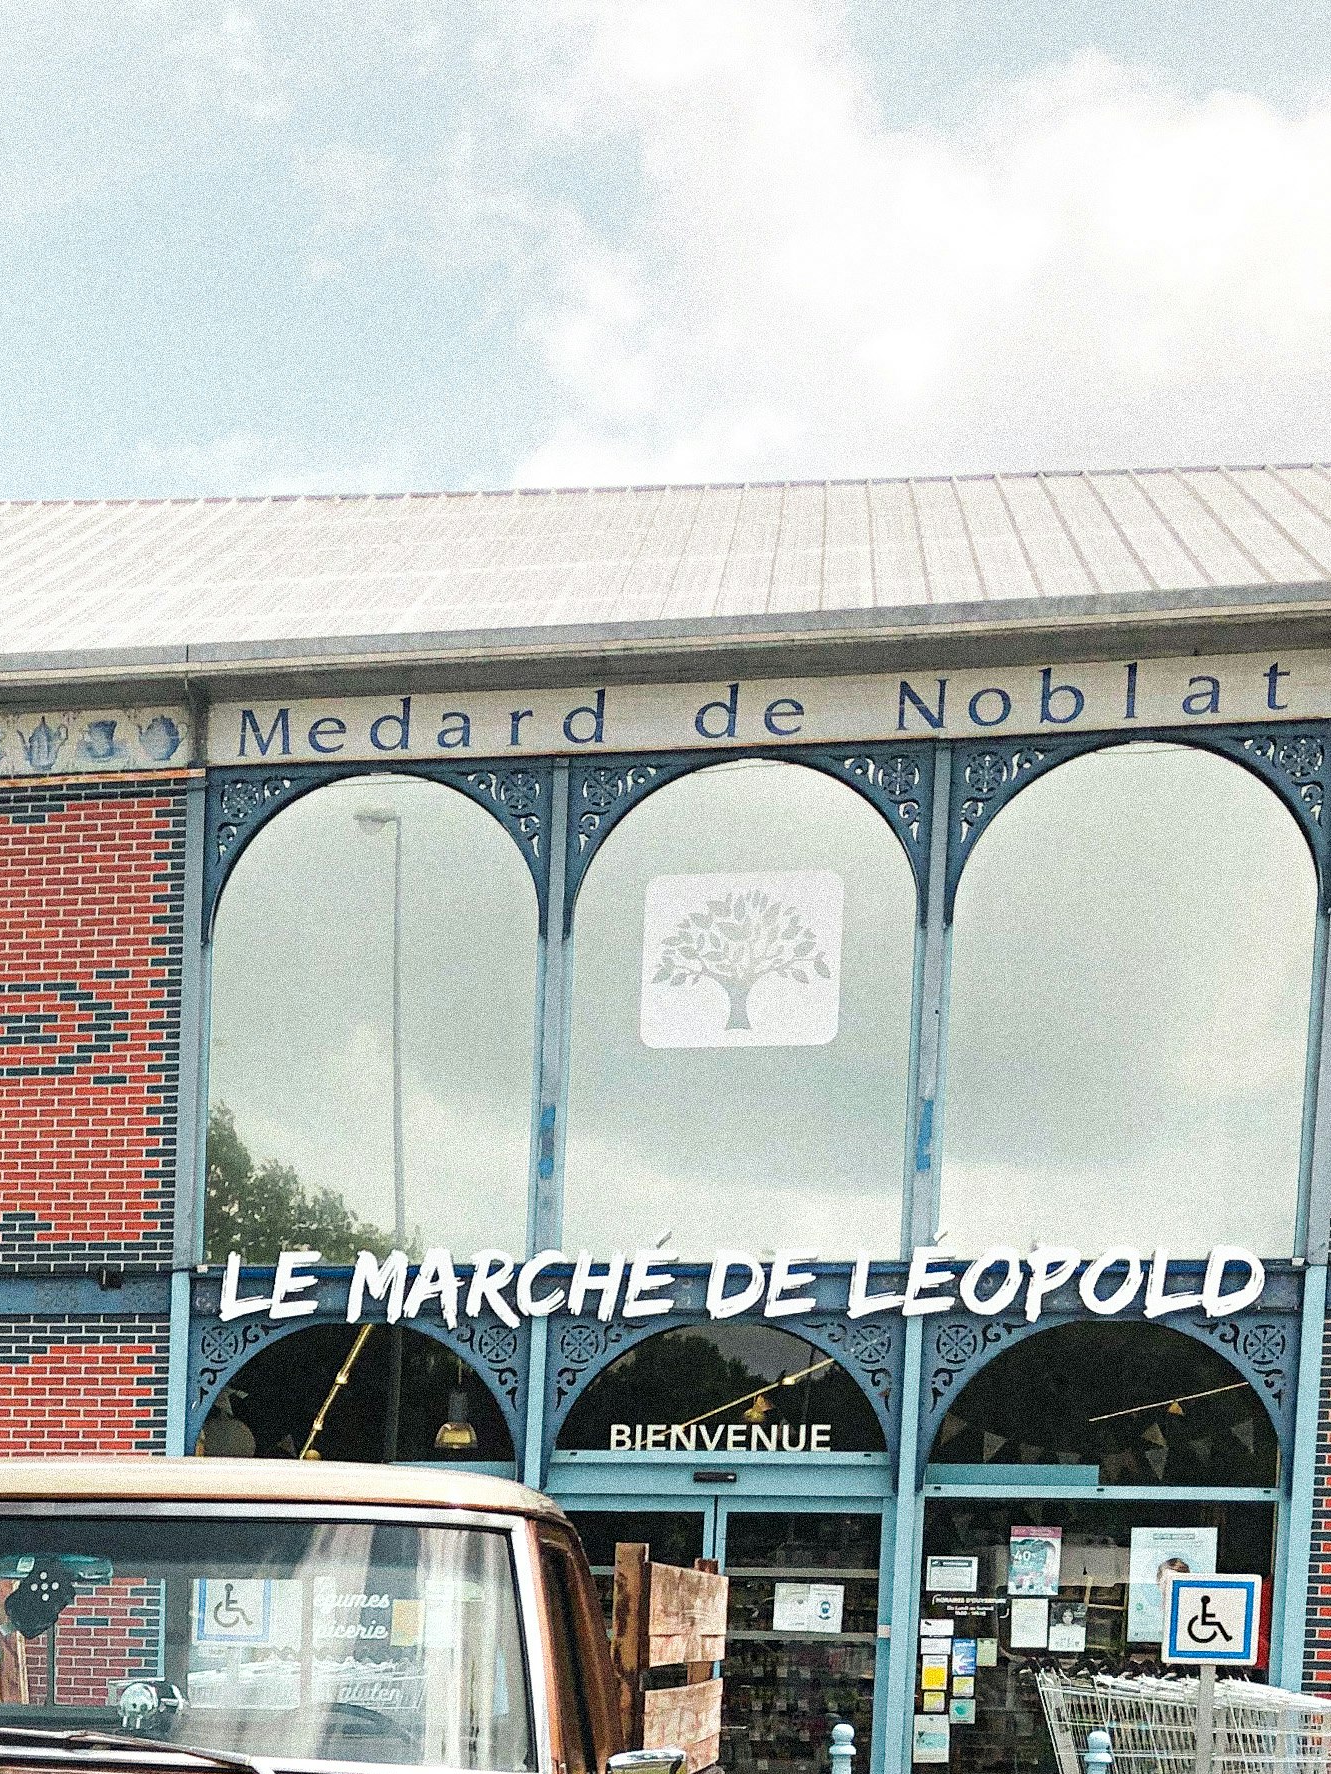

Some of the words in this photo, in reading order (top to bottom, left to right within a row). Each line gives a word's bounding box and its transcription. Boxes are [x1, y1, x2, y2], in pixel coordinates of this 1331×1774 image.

[236, 688, 606, 758] Medard
[695, 684, 806, 739] de
[895, 657, 1293, 733] Noblat
[219, 1249, 323, 1323] LE
[345, 1233, 680, 1330] MARCHÉ
[704, 1247, 818, 1321] DE
[846, 1229, 1266, 1323] LÉOPOLD
[609, 1423, 832, 1453] BIENVENUE
